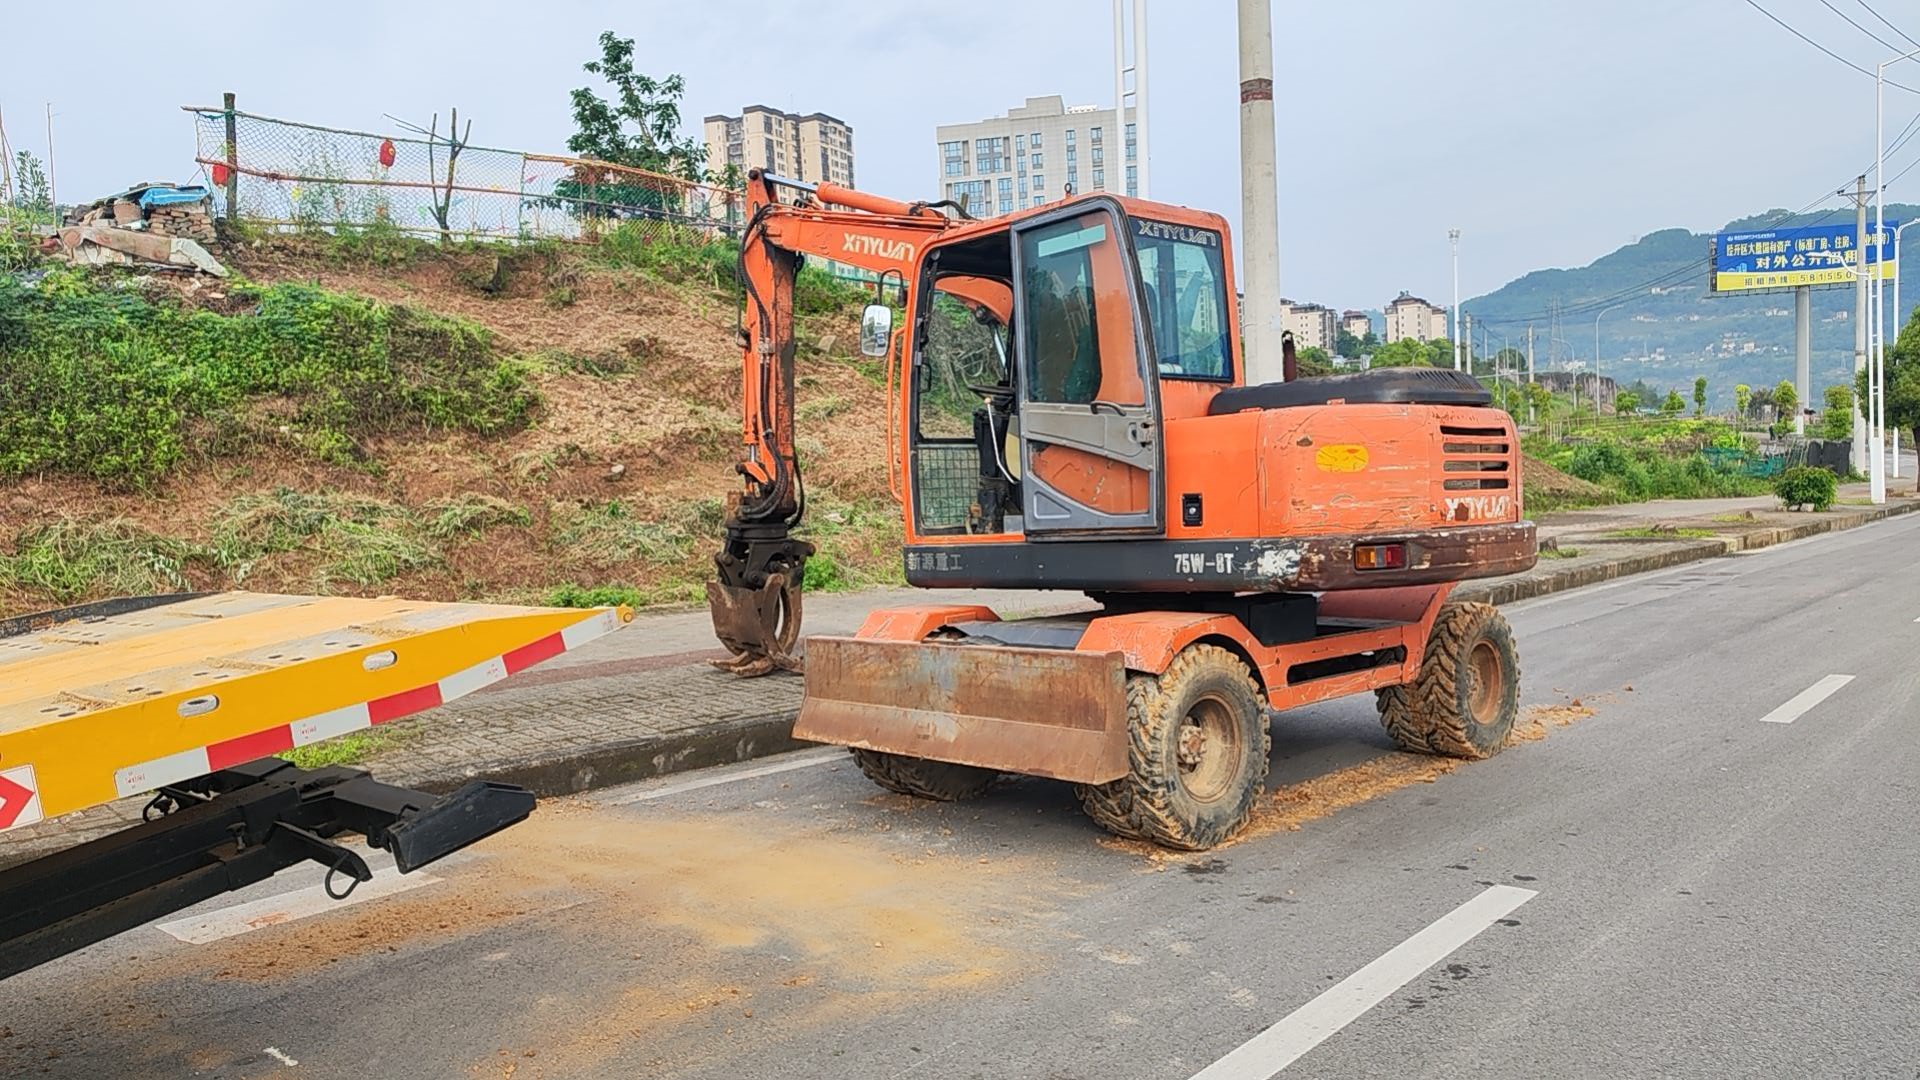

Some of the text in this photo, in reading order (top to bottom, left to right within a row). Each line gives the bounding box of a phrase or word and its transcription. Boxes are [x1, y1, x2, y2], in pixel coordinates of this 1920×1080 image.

[907, 552, 963, 572] 新源重工
[1174, 553, 1234, 574] 75W-8T
